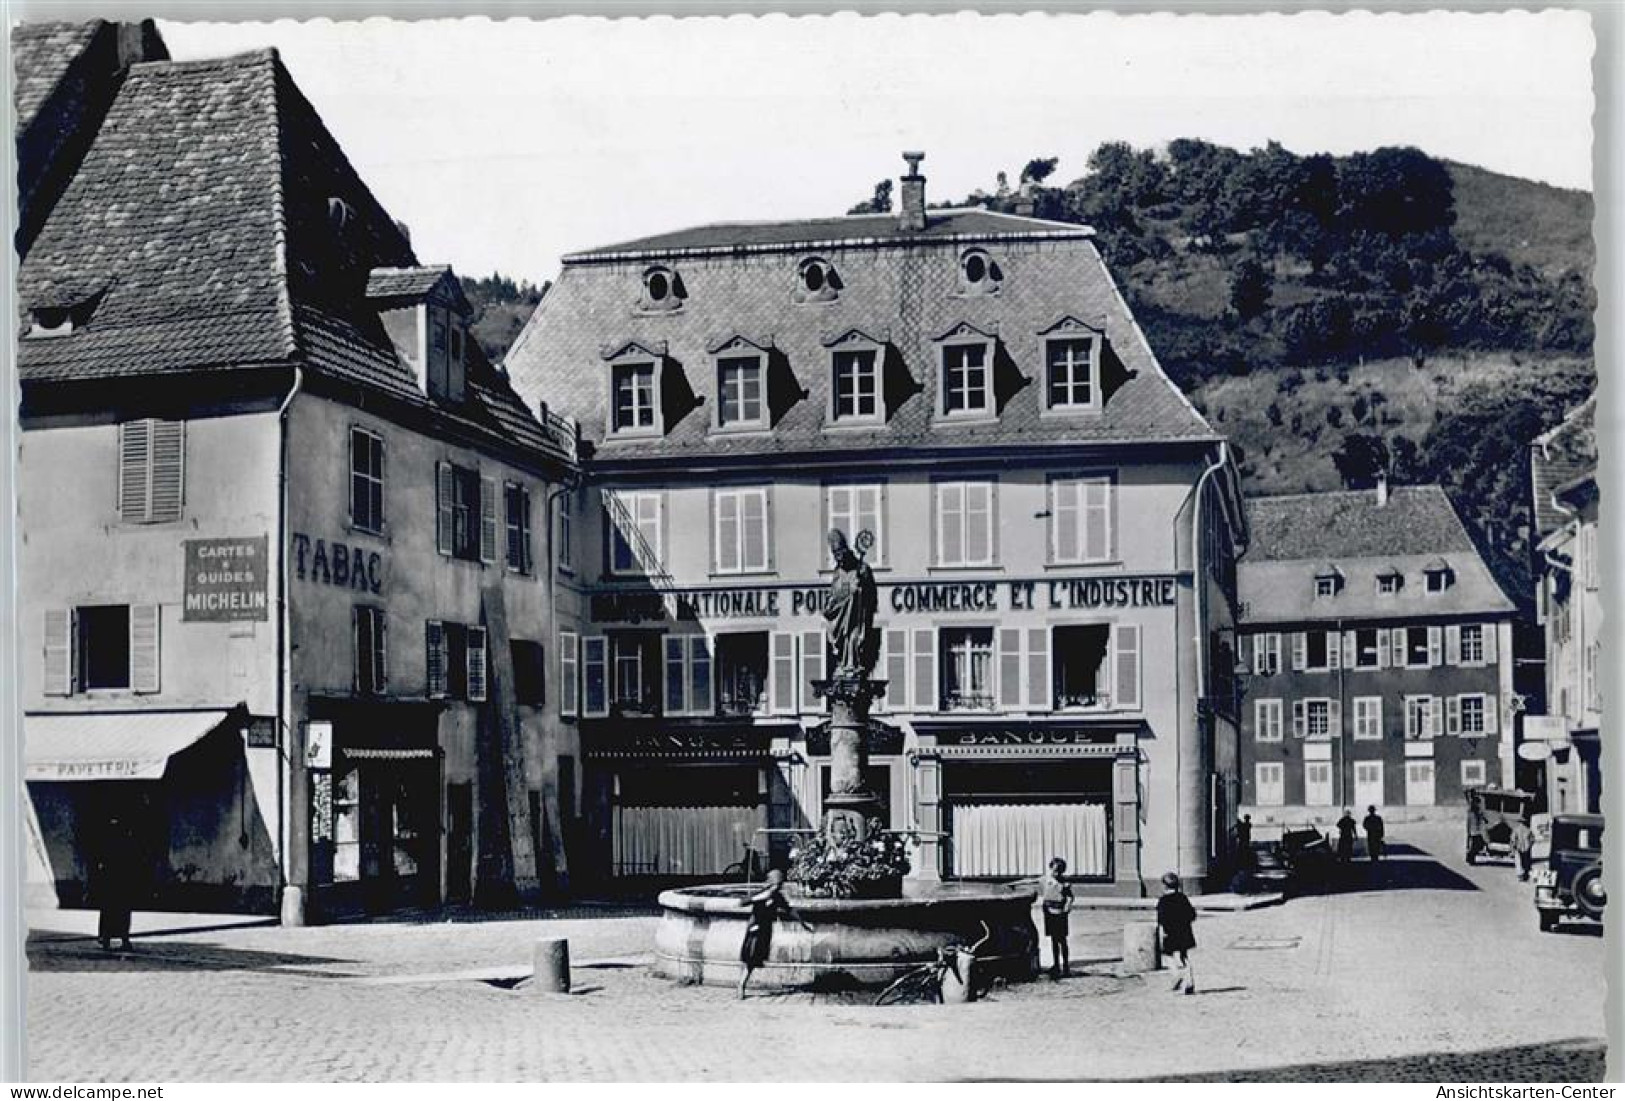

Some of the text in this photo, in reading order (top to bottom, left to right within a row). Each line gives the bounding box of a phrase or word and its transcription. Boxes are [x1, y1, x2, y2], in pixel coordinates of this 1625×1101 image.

[198, 545, 255, 558] CARTES
[293, 533, 382, 595] TABAC
[197, 571, 255, 584] GUIDES
[187, 591, 265, 610] MICHELIN
[675, 590, 780, 621] NATIONALE
[792, 590, 830, 617] POU
[891, 583, 998, 614] COMMERCE
[1010, 581, 1036, 611] ET
[1050, 578, 1176, 610] L'INDUSTRIE
